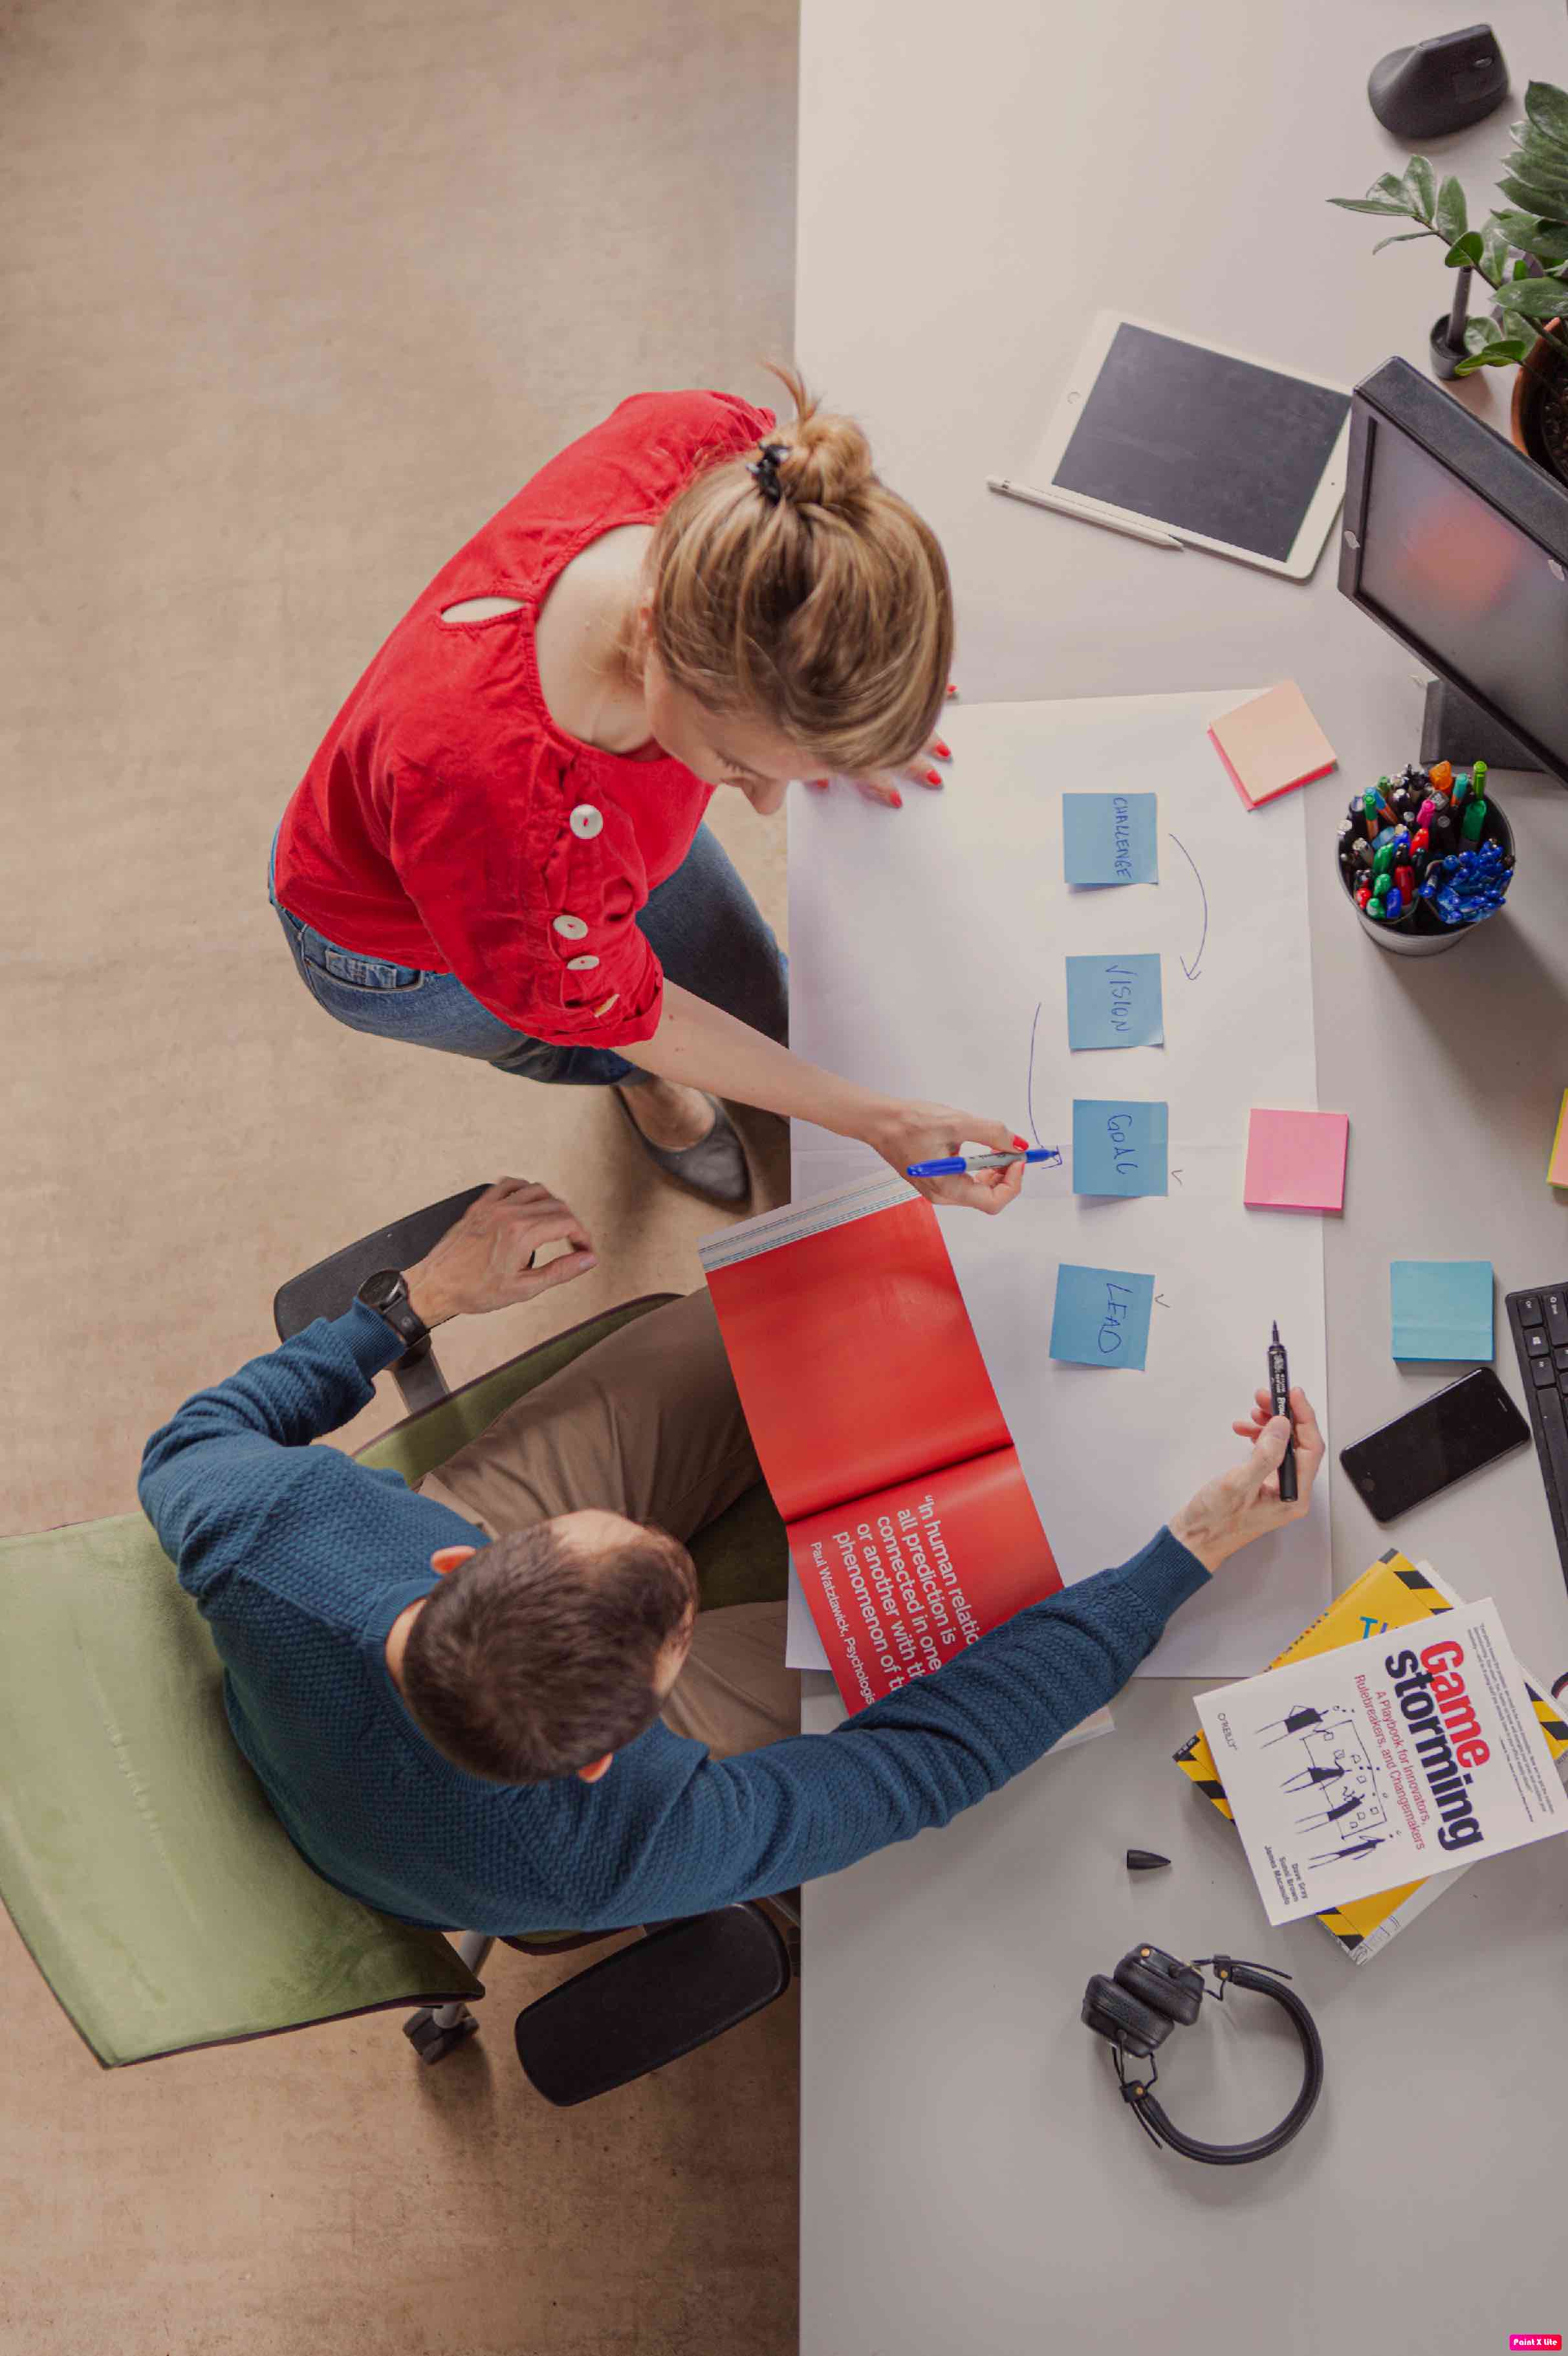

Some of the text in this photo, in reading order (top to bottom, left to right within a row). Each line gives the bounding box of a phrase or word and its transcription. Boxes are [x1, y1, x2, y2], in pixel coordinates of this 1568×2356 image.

[1113, 797, 1133, 879] CHALLENGE
[1105, 965, 1138, 1031] VISION
[1107, 1114, 1139, 1175] GOAL
[1098, 1283, 1134, 1353] LEAD
[857, 1523, 873, 1541] or
[924, 1520, 959, 1587] human
[811, 1542, 827, 1568] Paul
[819, 1566, 849, 1637] Watzlawick,
[833, 1532, 889, 1652] phenomenon
[880, 1655, 902, 1673] of
[862, 1545, 900, 1616] another
[877, 1516, 942, 1671] connected in one
[897, 1509, 957, 1644] all prediction is
[891, 1620, 917, 1661] with
[1379, 1699, 1405, 1749] Playbook
[1420, 1641, 1490, 1769] Game
[1355, 1674, 1426, 1850] Rulebreakers, and Changemakers
[1385, 1649, 1485, 1851] storming
[1397, 1749, 1410, 1764] for
[1403, 1765, 1430, 1825] Innovators,
